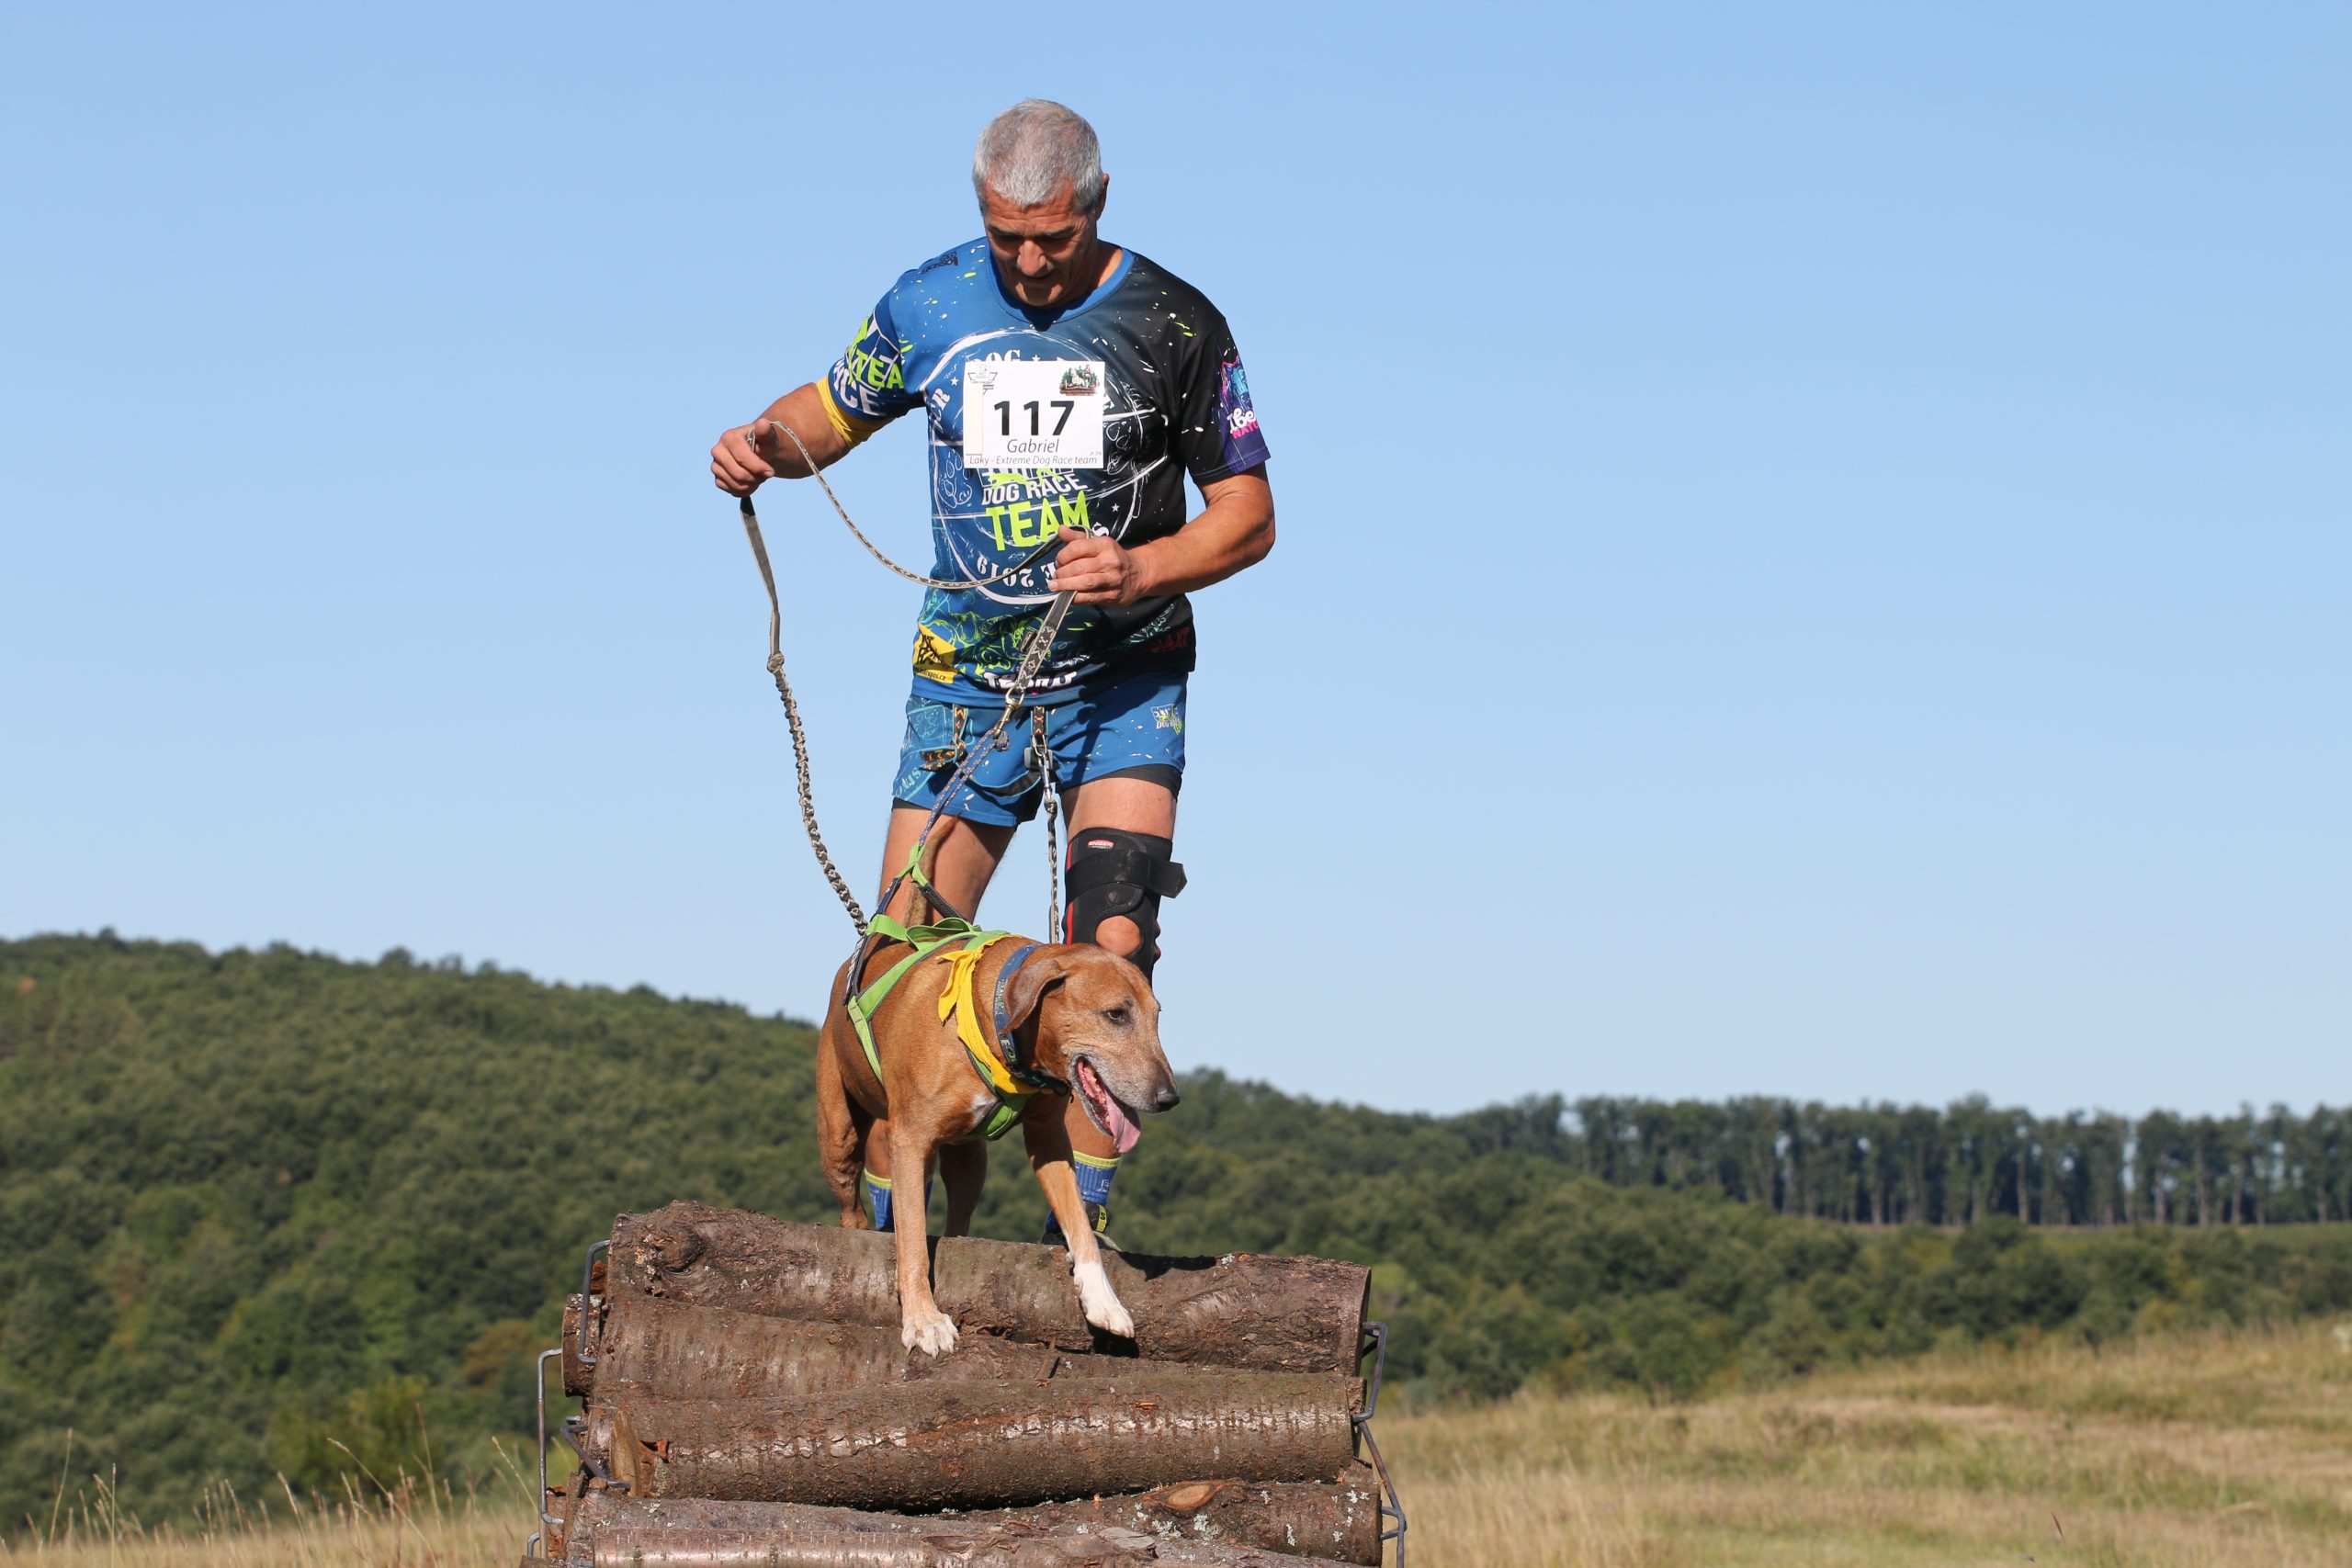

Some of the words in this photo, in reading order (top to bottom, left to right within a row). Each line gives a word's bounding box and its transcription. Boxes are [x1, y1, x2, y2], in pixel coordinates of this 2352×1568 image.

[994, 400, 1075, 436] 117
[969, 456, 989, 465] Laky
[996, 456, 1031, 465] Extreme
[1033, 456, 1050, 466] Dog
[1052, 456, 1073, 465] Race
[1075, 456, 1097, 465] team
[1007, 438, 1059, 453] Gabriel
[981, 482, 1021, 506] DOG
[1026, 473, 1089, 500] RACE
[985, 490, 1091, 551] TEAM
